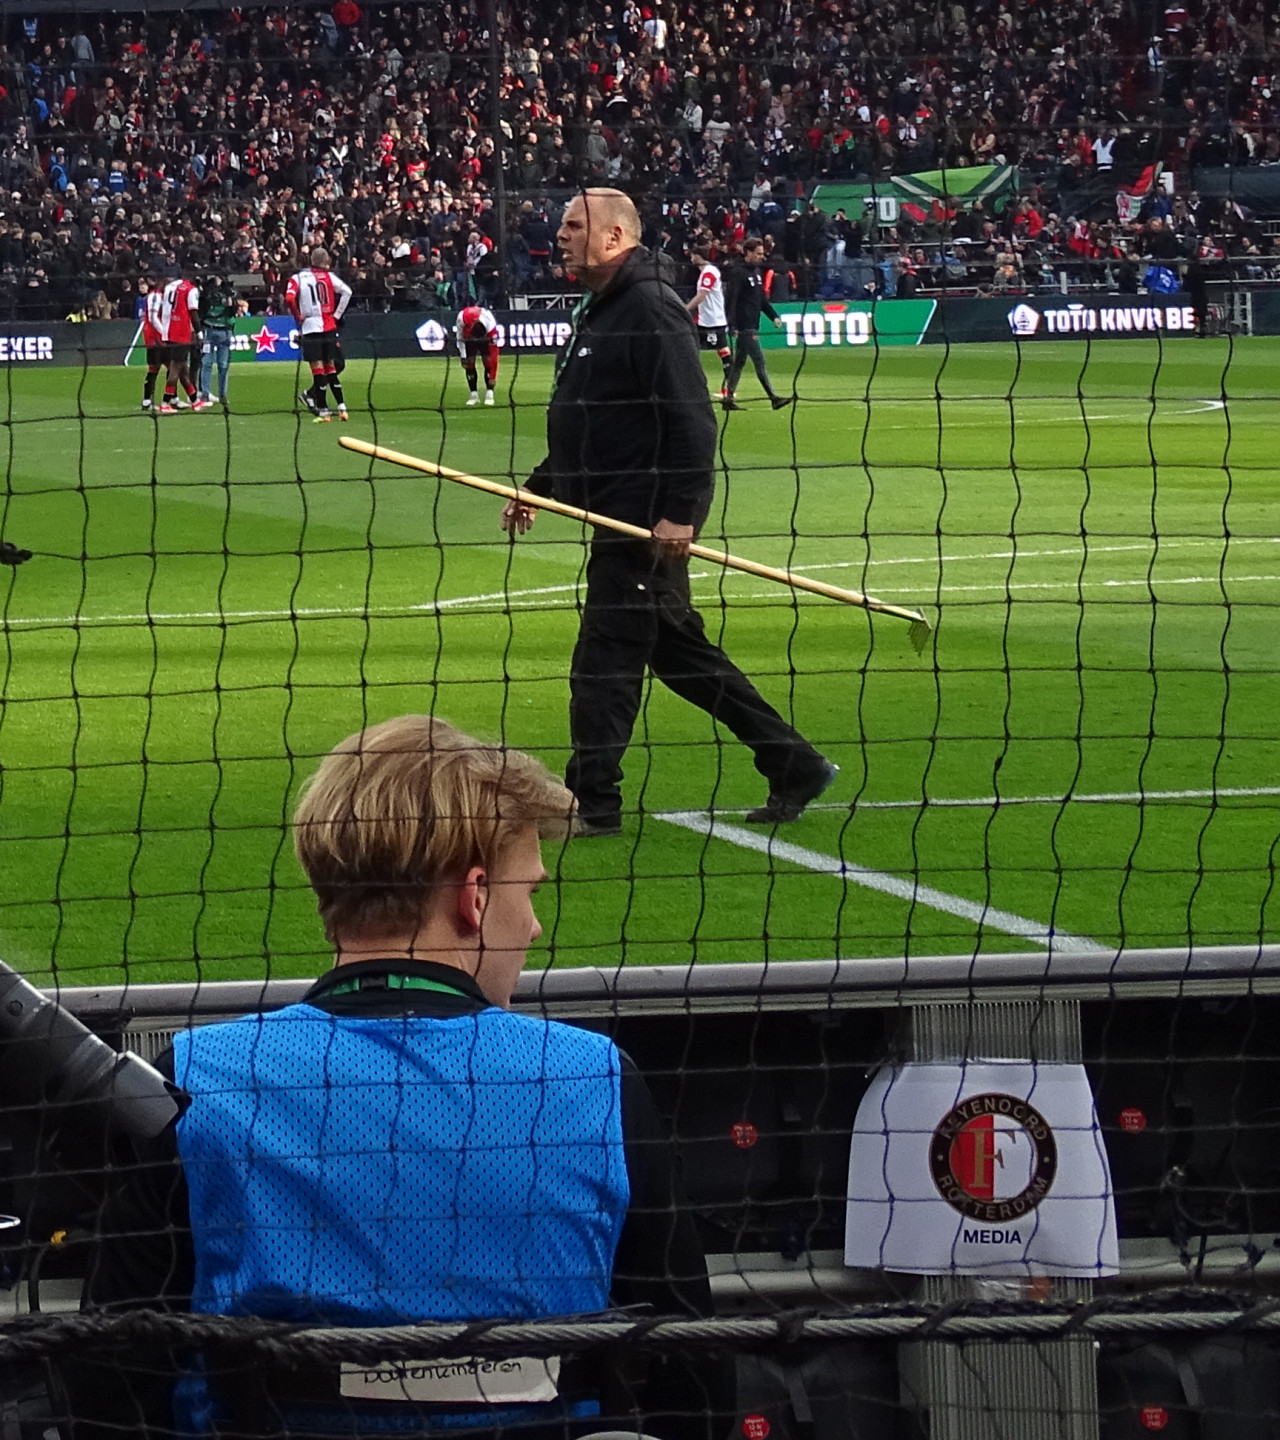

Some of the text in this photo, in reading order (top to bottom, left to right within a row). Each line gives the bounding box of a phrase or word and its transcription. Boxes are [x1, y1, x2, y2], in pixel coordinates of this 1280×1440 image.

[306, 283, 330, 306] 10
[781, 311, 870, 347] TOTO
[1043, 308, 1097, 333] TOTO
[963, 1229, 1022, 1245] MEDIA
